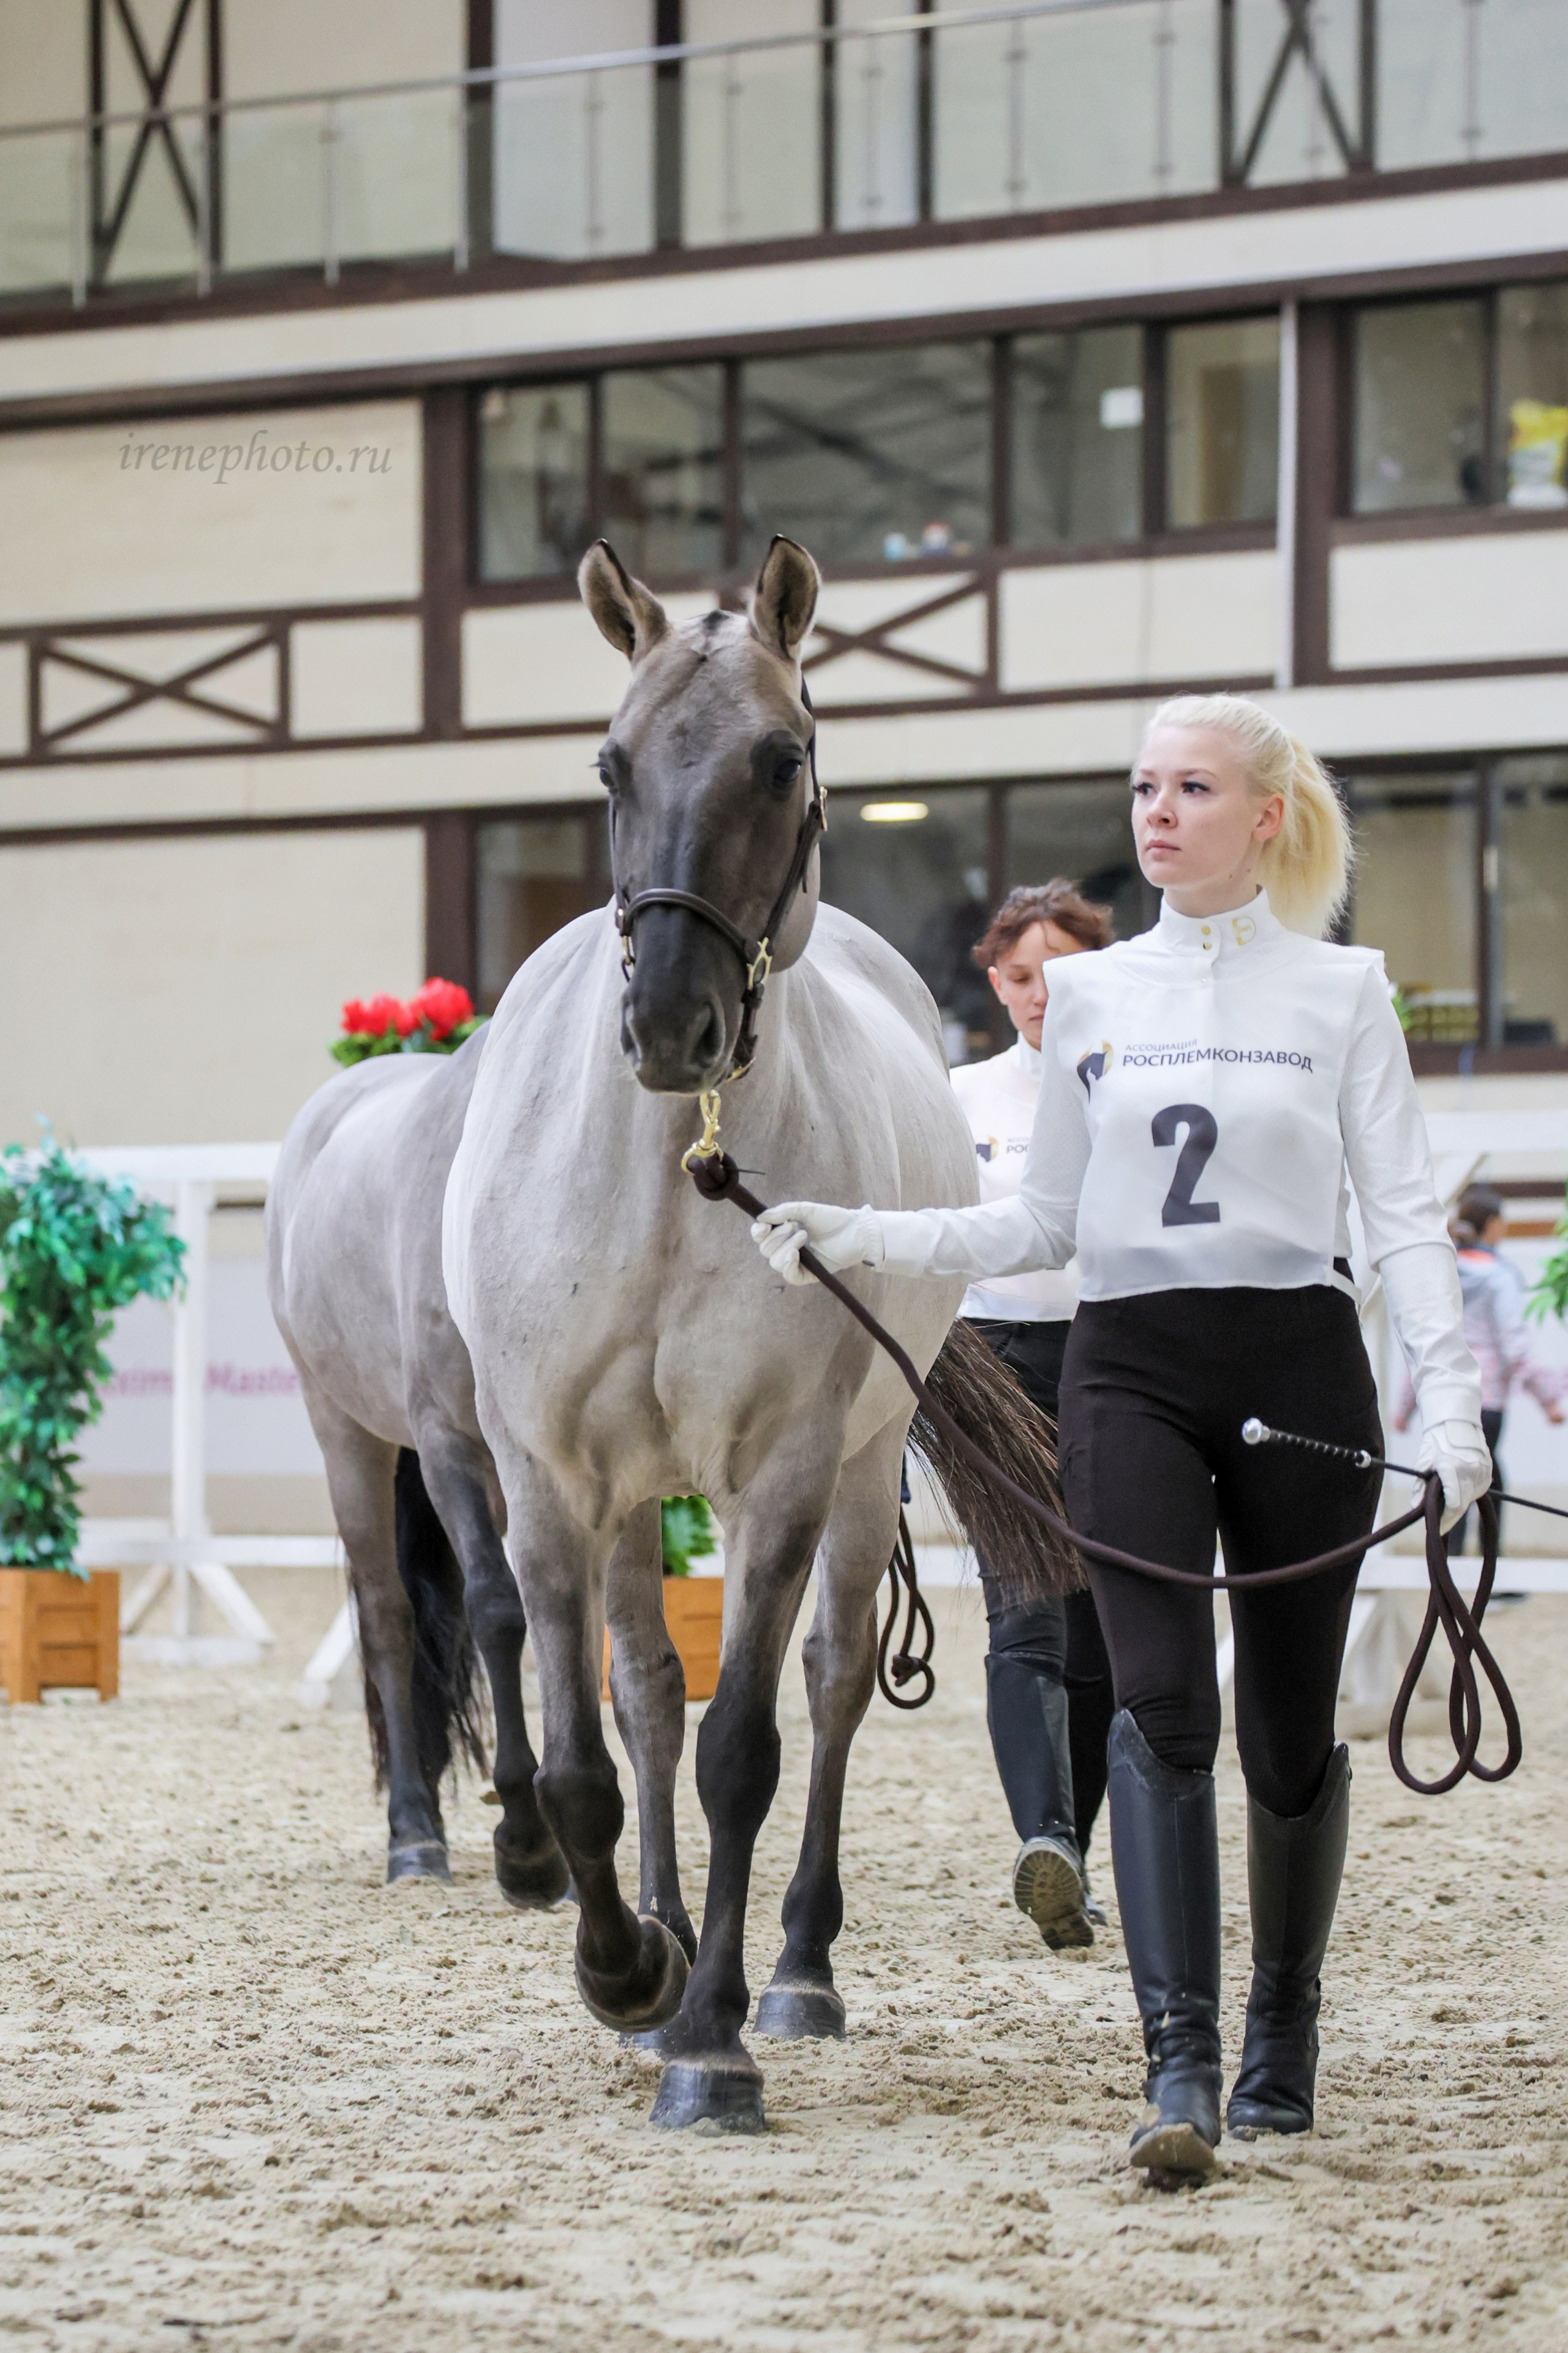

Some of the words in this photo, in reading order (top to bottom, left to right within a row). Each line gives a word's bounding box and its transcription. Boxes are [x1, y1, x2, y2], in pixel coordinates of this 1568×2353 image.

[1125, 1039, 1197, 1052] АССОЦИАЦИЯ
[1123, 1048, 1313, 1074] РОСПЛЕМКОНЗАВОД
[1152, 1103, 1221, 1228] 2
